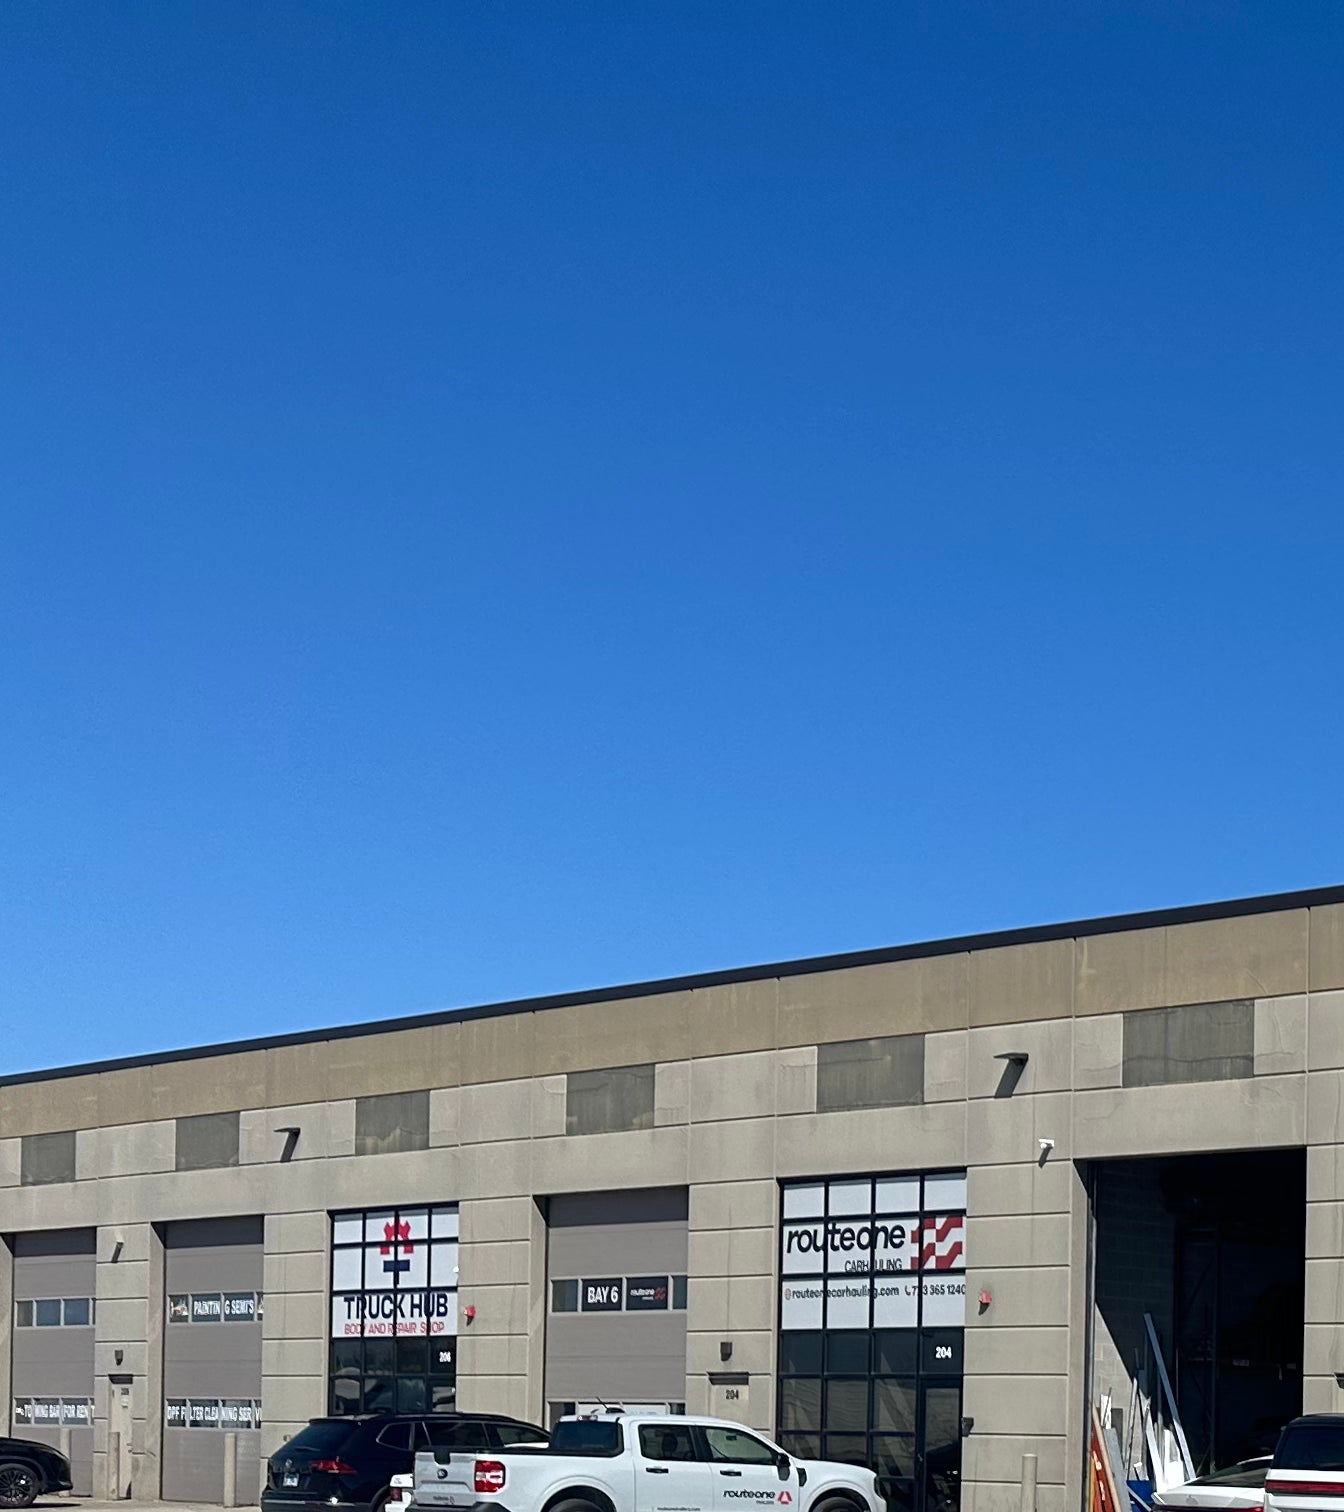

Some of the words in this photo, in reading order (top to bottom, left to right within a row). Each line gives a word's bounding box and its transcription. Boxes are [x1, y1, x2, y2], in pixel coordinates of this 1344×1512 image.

[786, 1222, 906, 1254] routeone
[844, 1257, 903, 1273] CARHULING
[587, 1286, 610, 1304] BAY
[610, 1285, 620, 1304] 6
[929, 1284, 946, 1296] 365
[343, 1294, 406, 1320] TRUCK
[410, 1292, 448, 1318] HUB
[369, 1322, 386, 1334] AND
[388, 1321, 417, 1334] RPAIR
[420, 1320, 445, 1333] SOP
[935, 1346, 952, 1359] 204
[725, 1389, 739, 1400] 204
[722, 1488, 776, 1499] routeone
